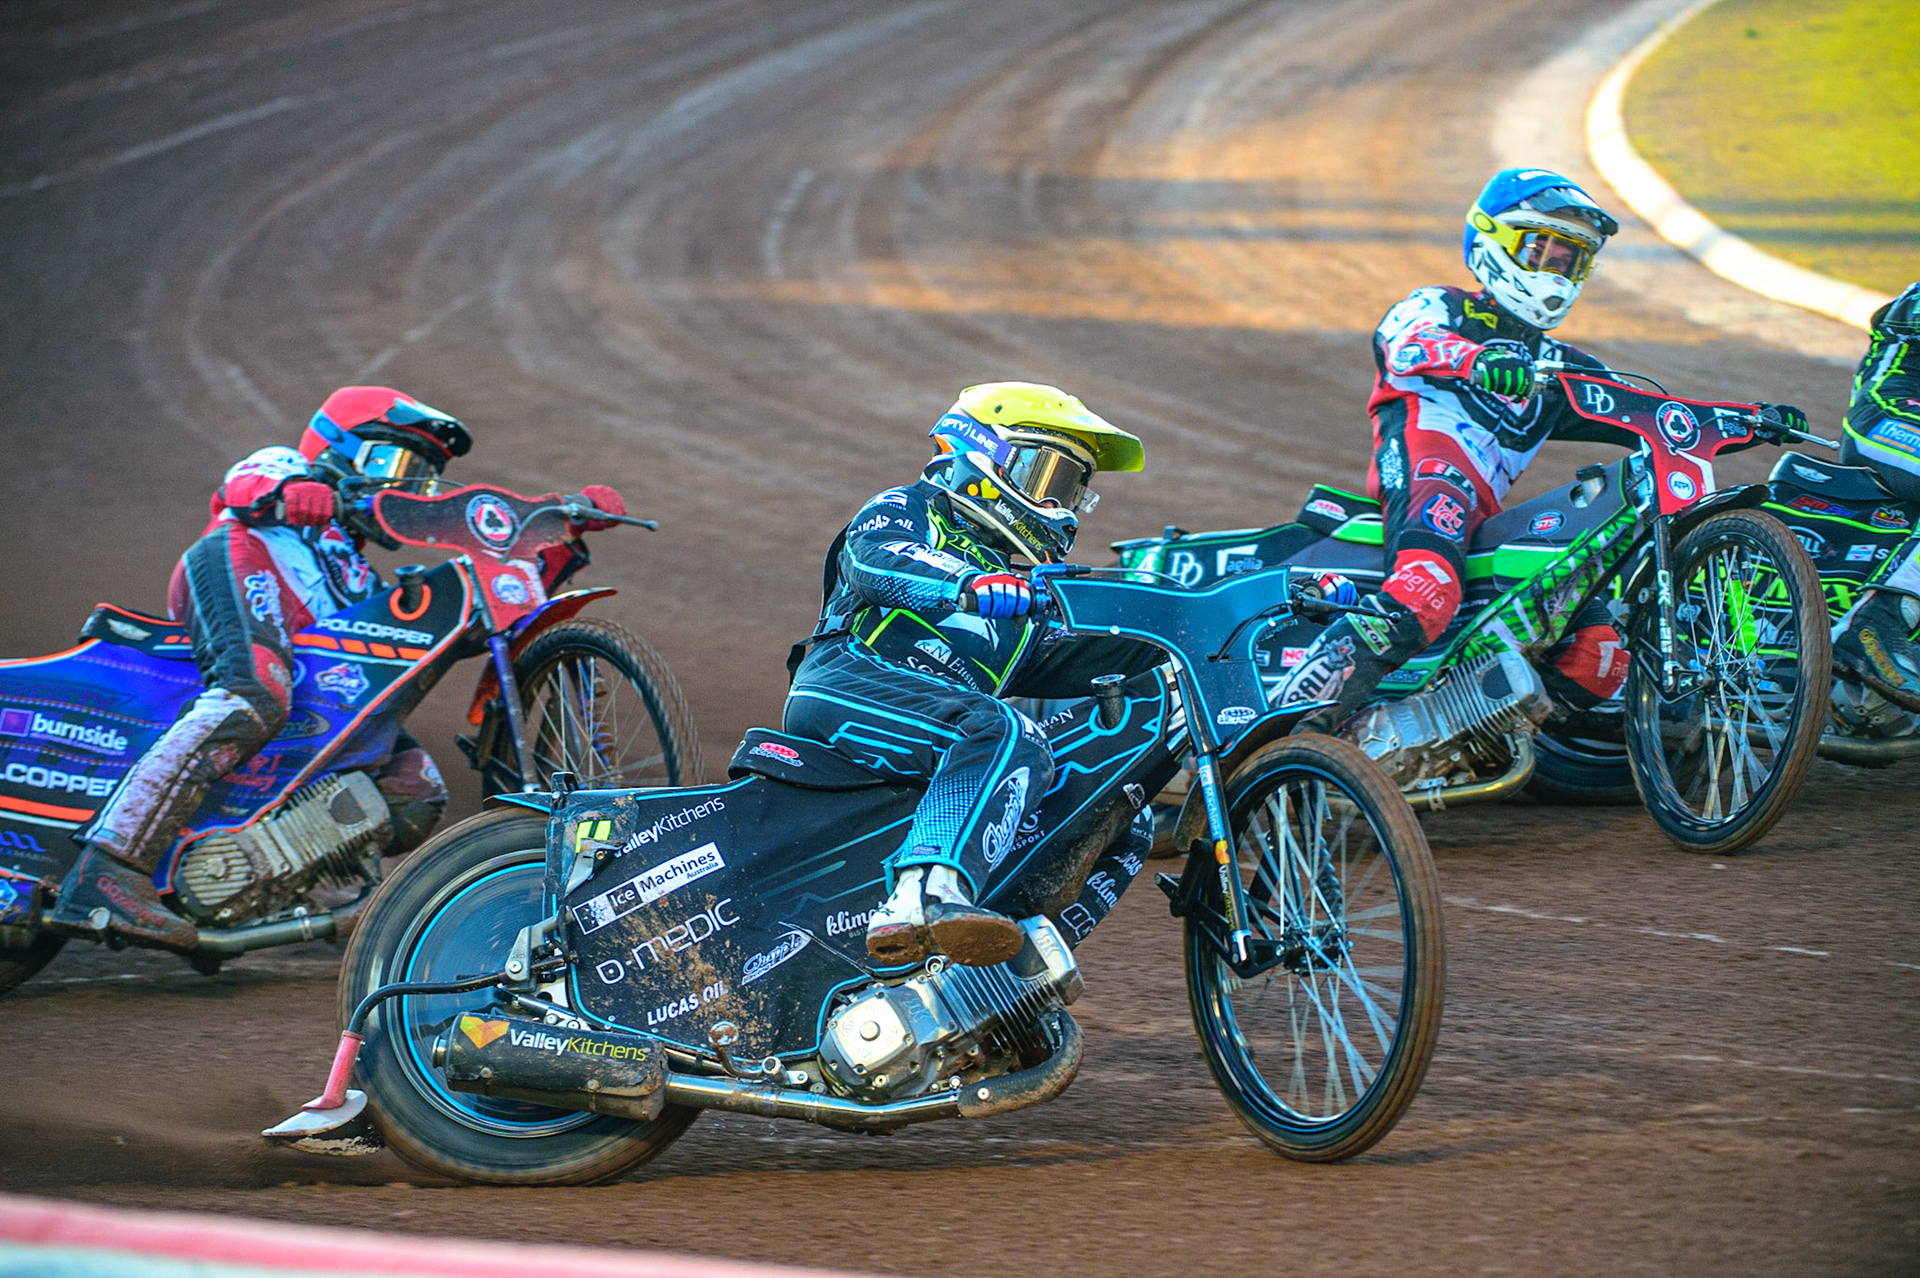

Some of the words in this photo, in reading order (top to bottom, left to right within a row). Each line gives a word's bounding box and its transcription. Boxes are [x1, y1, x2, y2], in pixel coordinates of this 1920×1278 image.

[994, 499, 1044, 551] ValleyKitchens
[1399, 568, 1445, 611] agilia
[314, 618, 435, 646] POLCOPPER
[31, 712, 129, 751] burnside
[609, 888, 636, 908] Ice
[639, 851, 716, 893] Machines
[686, 861, 719, 880] Australia
[646, 993, 700, 1026] LUCAS
[702, 980, 730, 1005] OIL
[510, 1028, 647, 1062] ValleyKitchens
